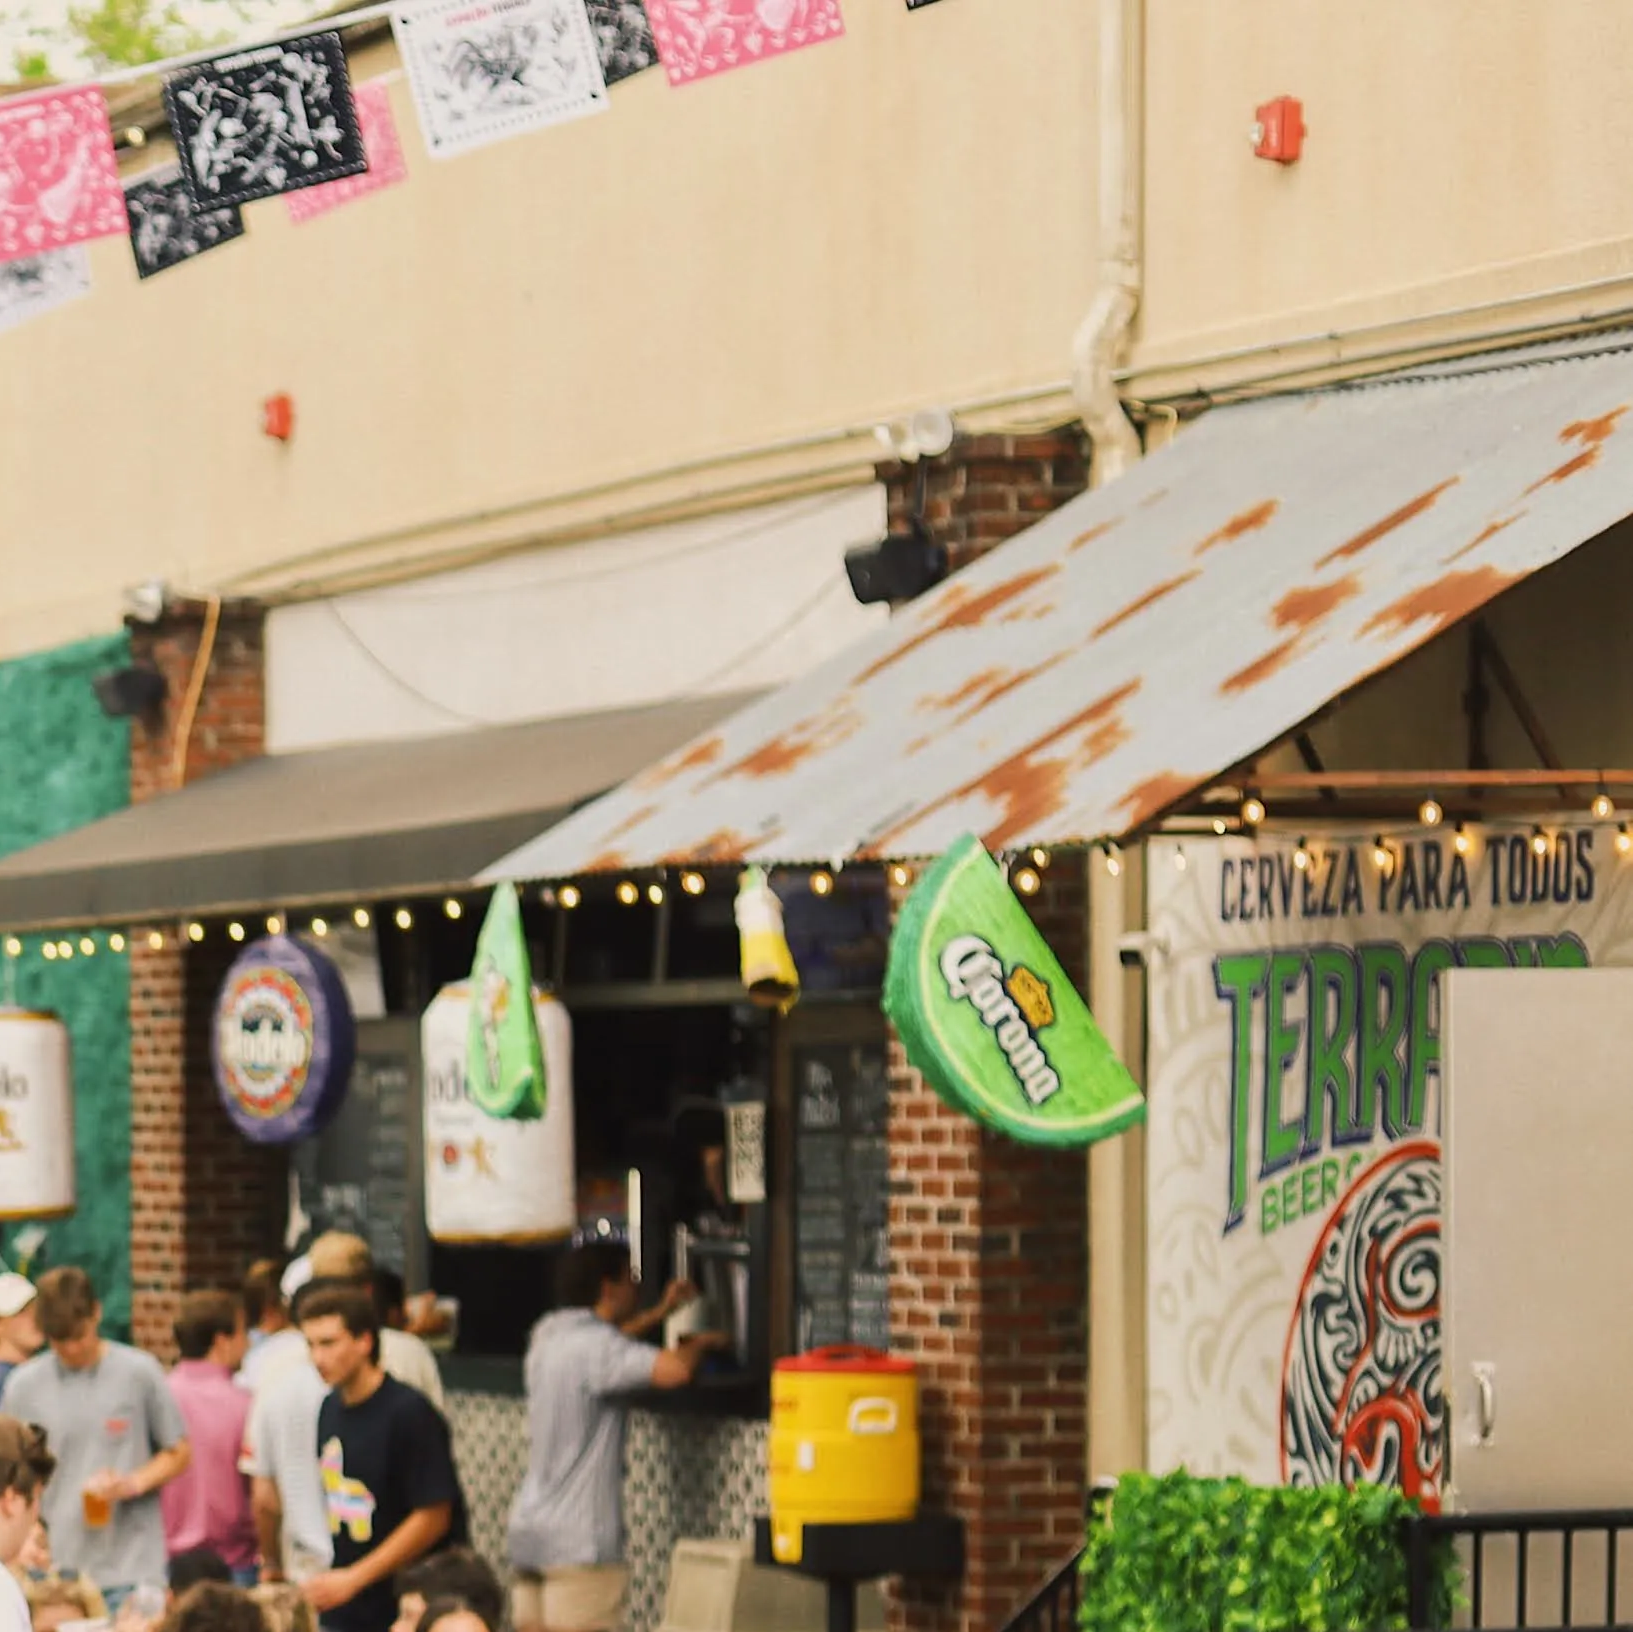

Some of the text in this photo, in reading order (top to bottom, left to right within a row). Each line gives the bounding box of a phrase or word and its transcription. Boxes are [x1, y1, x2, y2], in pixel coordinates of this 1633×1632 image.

[1220, 828, 1595, 922] CERVEZA PARA TODOS
[939, 934, 1061, 1104] Corona
[1212, 931, 1594, 1238] TERRA
[1261, 1162, 1337, 1235] BEER
